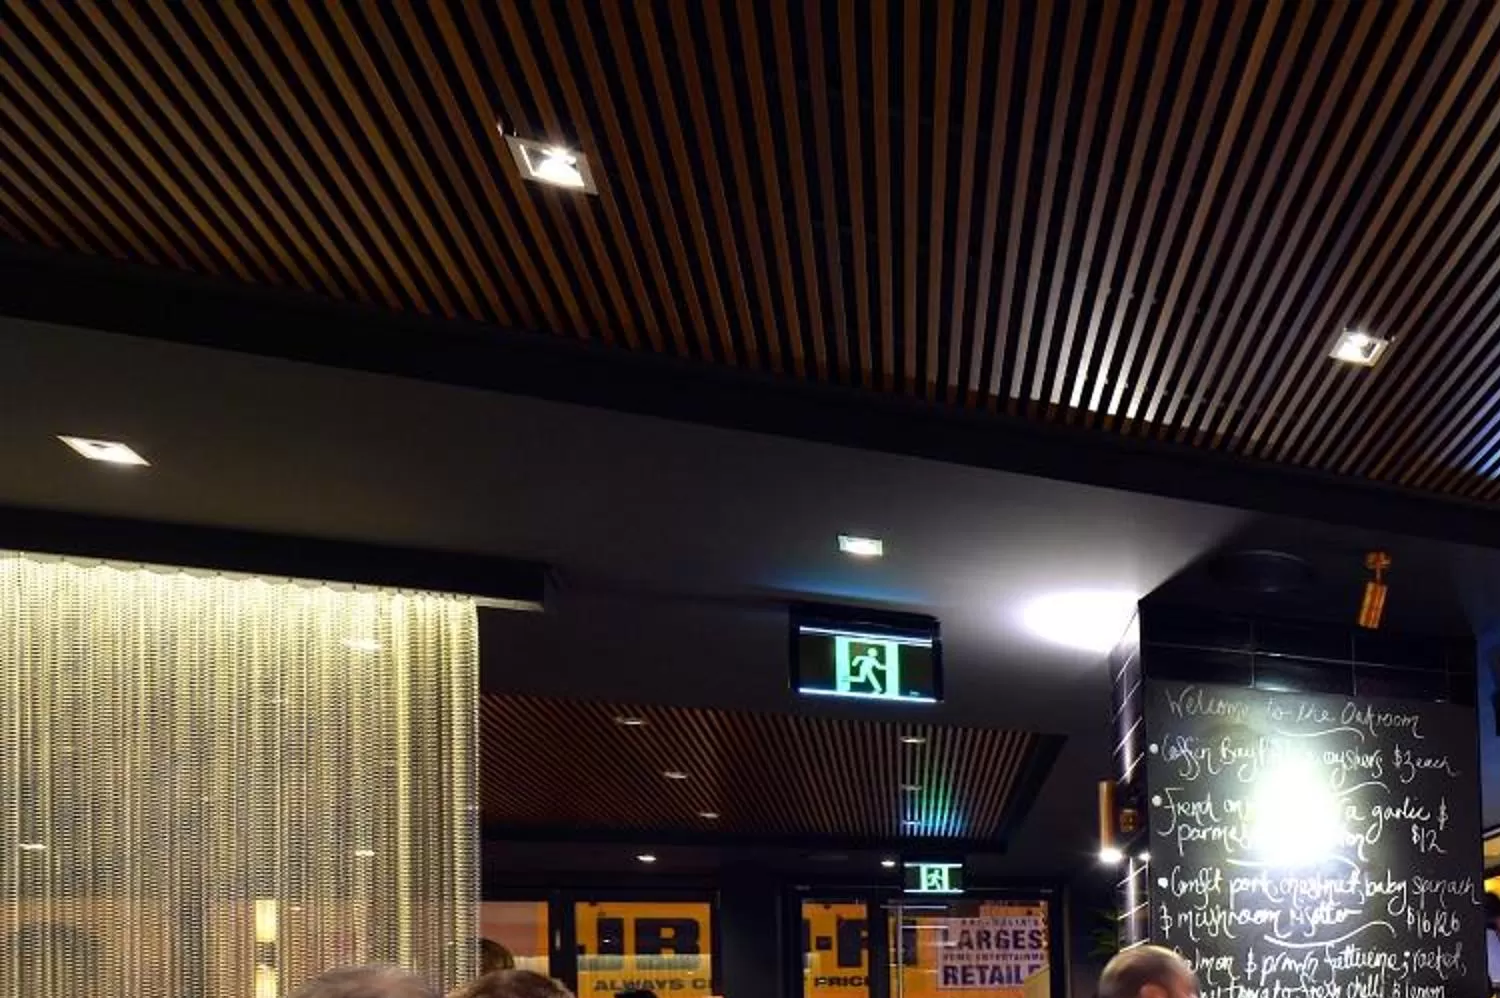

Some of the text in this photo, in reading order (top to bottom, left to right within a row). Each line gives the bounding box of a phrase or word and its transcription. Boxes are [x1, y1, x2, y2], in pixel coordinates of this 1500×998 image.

[1366, 796, 1431, 845] garlic
[1411, 823, 1449, 854] $12
[1363, 868, 1407, 917] baby
[1177, 904, 1292, 943] mushroom
[942, 928, 1043, 951] LARGES
[594, 977, 685, 991] ALWAYS
[814, 975, 869, 987] PRIC
[943, 964, 1041, 985] RETAIL
